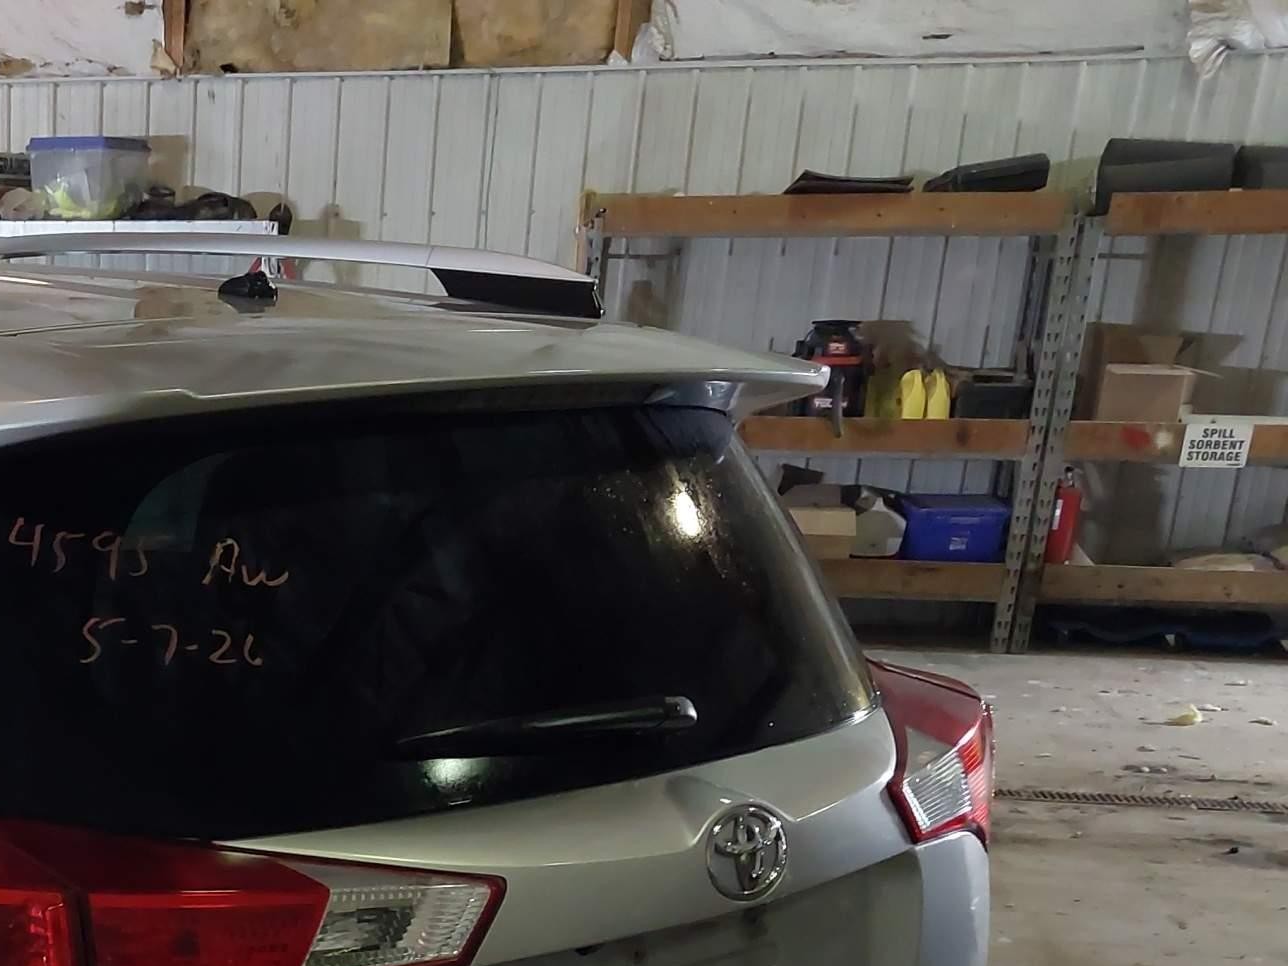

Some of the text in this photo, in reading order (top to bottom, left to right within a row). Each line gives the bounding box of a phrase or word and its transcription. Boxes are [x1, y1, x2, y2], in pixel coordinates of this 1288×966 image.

[1202, 428, 1235, 438] SPILL
[1188, 440, 1245, 450] SORBENT
[1186, 451, 1241, 462] STORAGE
[7, 516, 170, 582] 4595
[79, 617, 264, 667] 5-7-26
